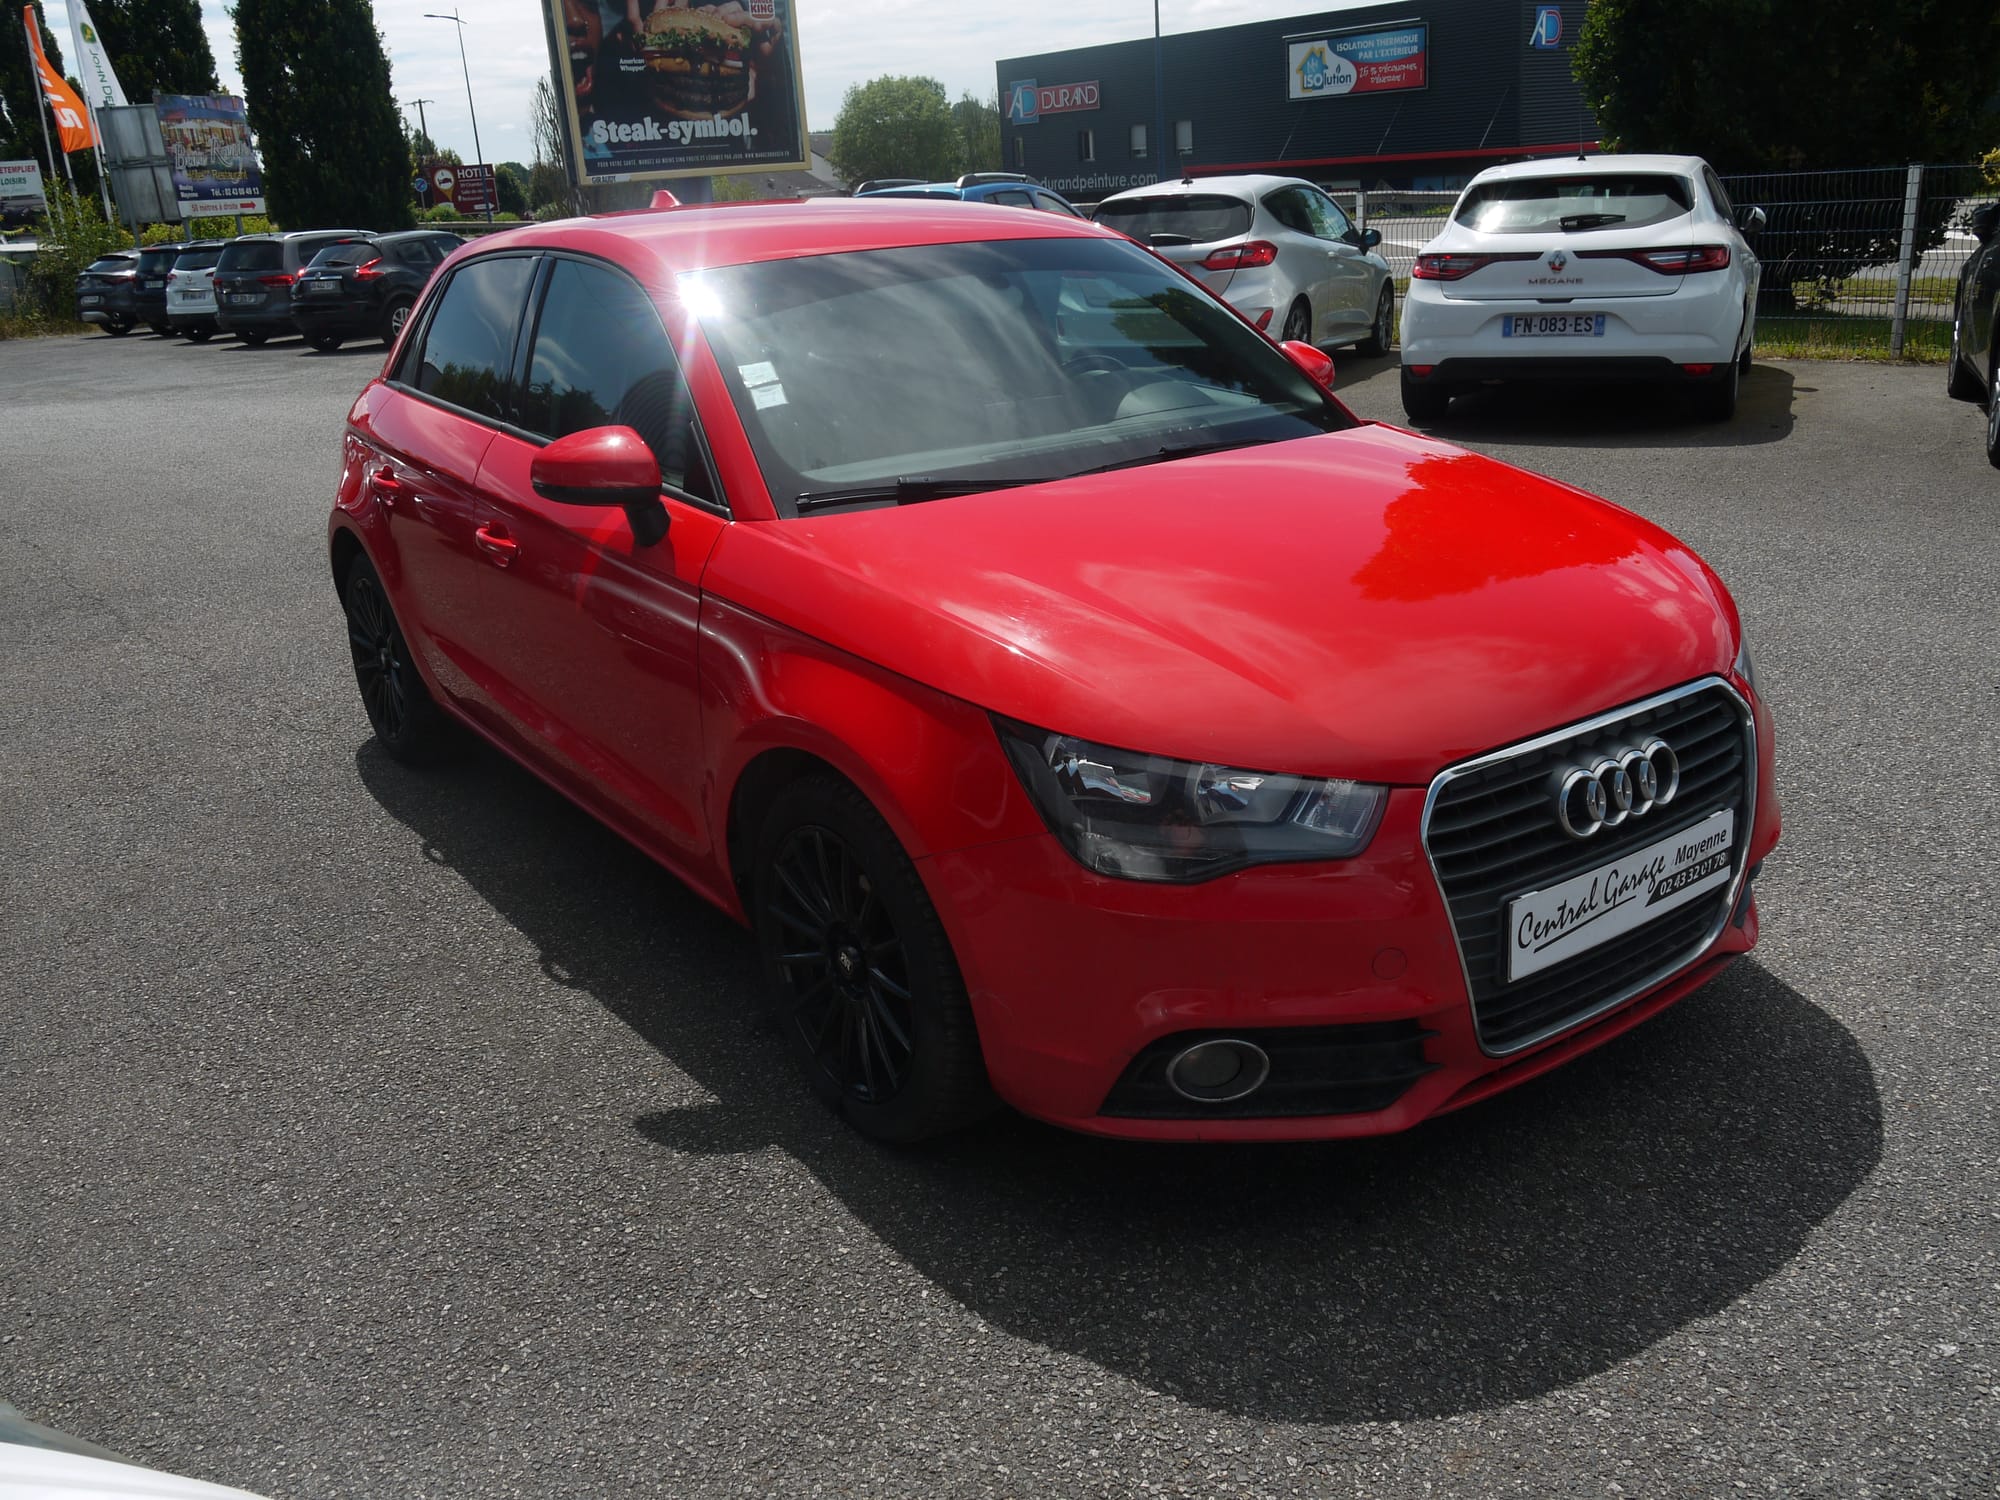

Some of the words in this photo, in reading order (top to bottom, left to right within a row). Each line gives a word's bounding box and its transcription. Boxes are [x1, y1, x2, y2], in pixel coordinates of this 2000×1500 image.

[751, 4, 773, 13] KING
[1336, 40, 1374, 52] ISOLATION
[1376, 34, 1418, 46] THERMIQUE
[89, 48, 108, 83] JOHN
[1359, 51, 1374, 60] PAR
[1041, 85, 1098, 109] DURAND
[592, 112, 758, 145] Steak-symbol.
[1041, 172, 1158, 192] durandpeinture.com
[1513, 316, 1593, 334] FN-083-ES
[1674, 828, 1727, 866] Mayenne
[1660, 878, 1673, 896] 02
[1674, 871, 1687, 889] 43
[1687, 865, 1700, 882] 32
[1700, 858, 1713, 876] 01
[1714, 852, 1726, 869] 78
[1518, 877, 1598, 949] Central
[1604, 856, 1666, 906] Garage
